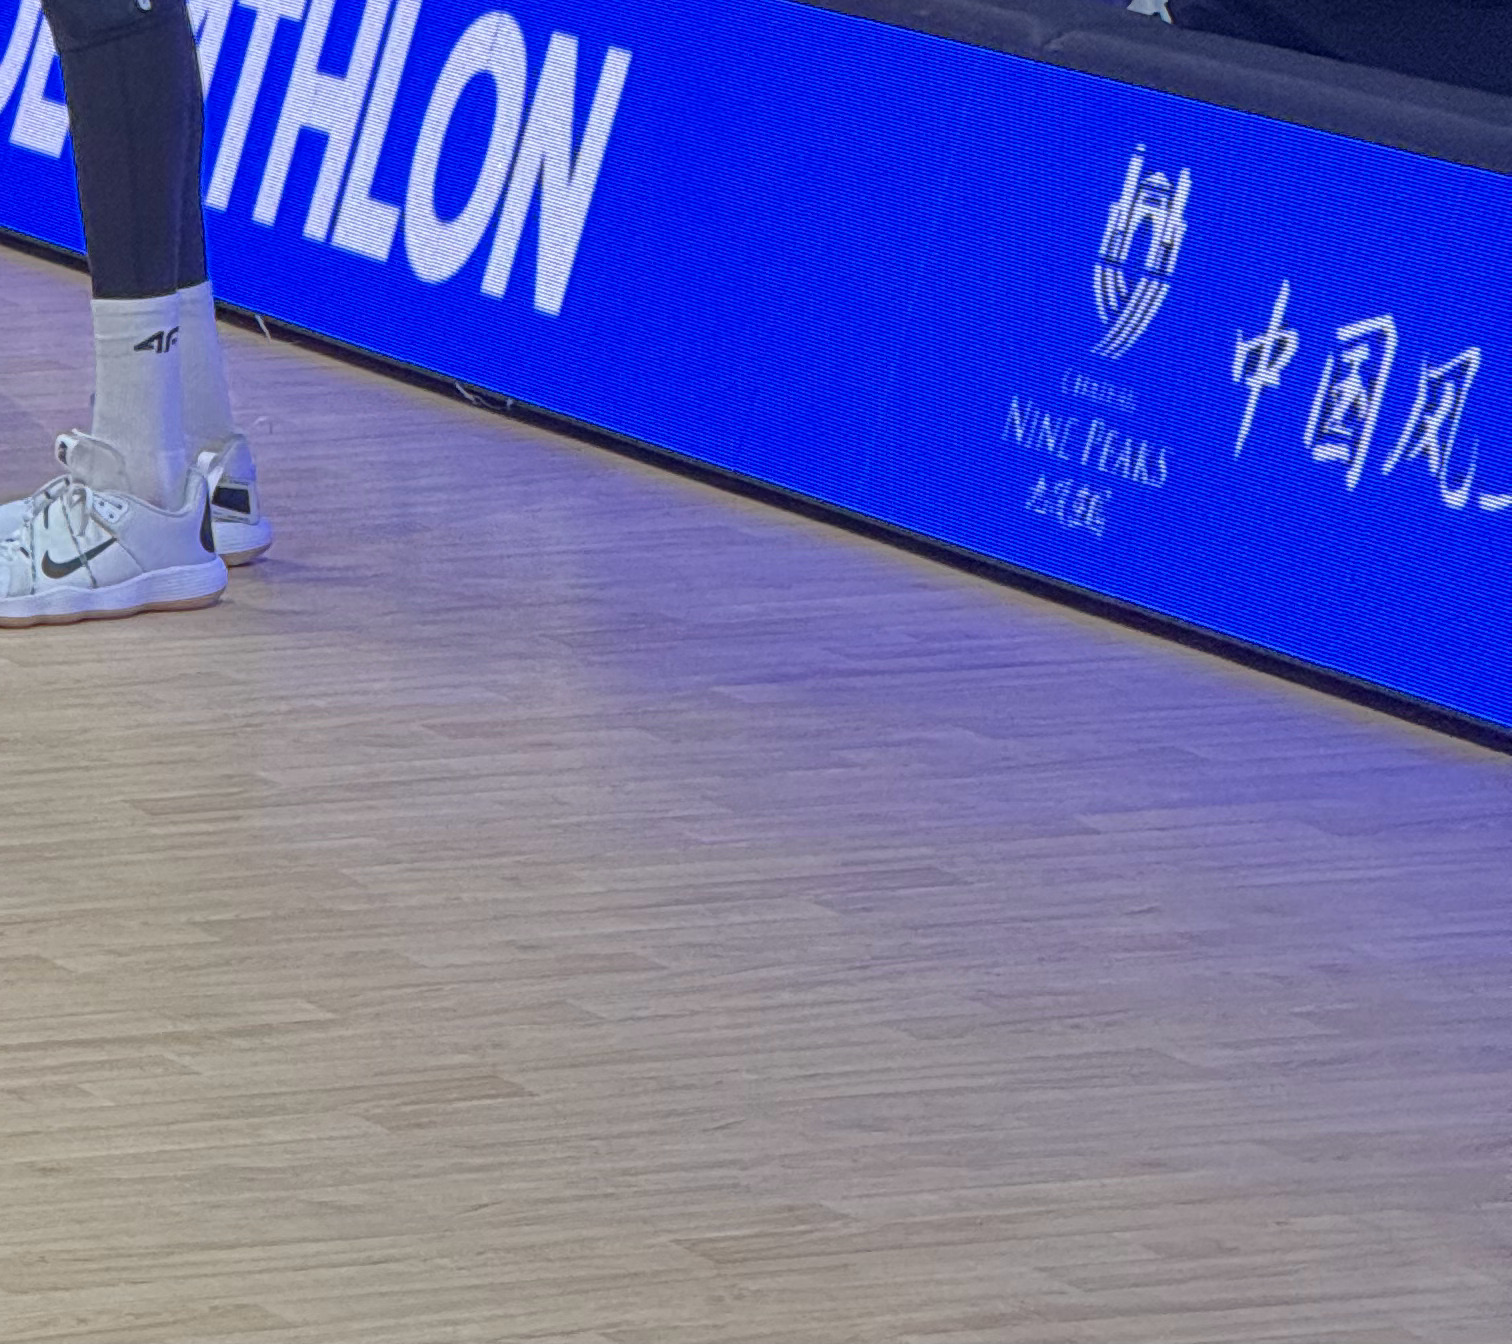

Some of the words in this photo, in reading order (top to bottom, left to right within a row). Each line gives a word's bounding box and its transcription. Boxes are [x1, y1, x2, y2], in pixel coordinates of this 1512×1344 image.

[1001, 394, 1079, 461] NINE
[1079, 418, 1175, 489] PEAKS
[1231, 278, 1512, 511] 中国风
